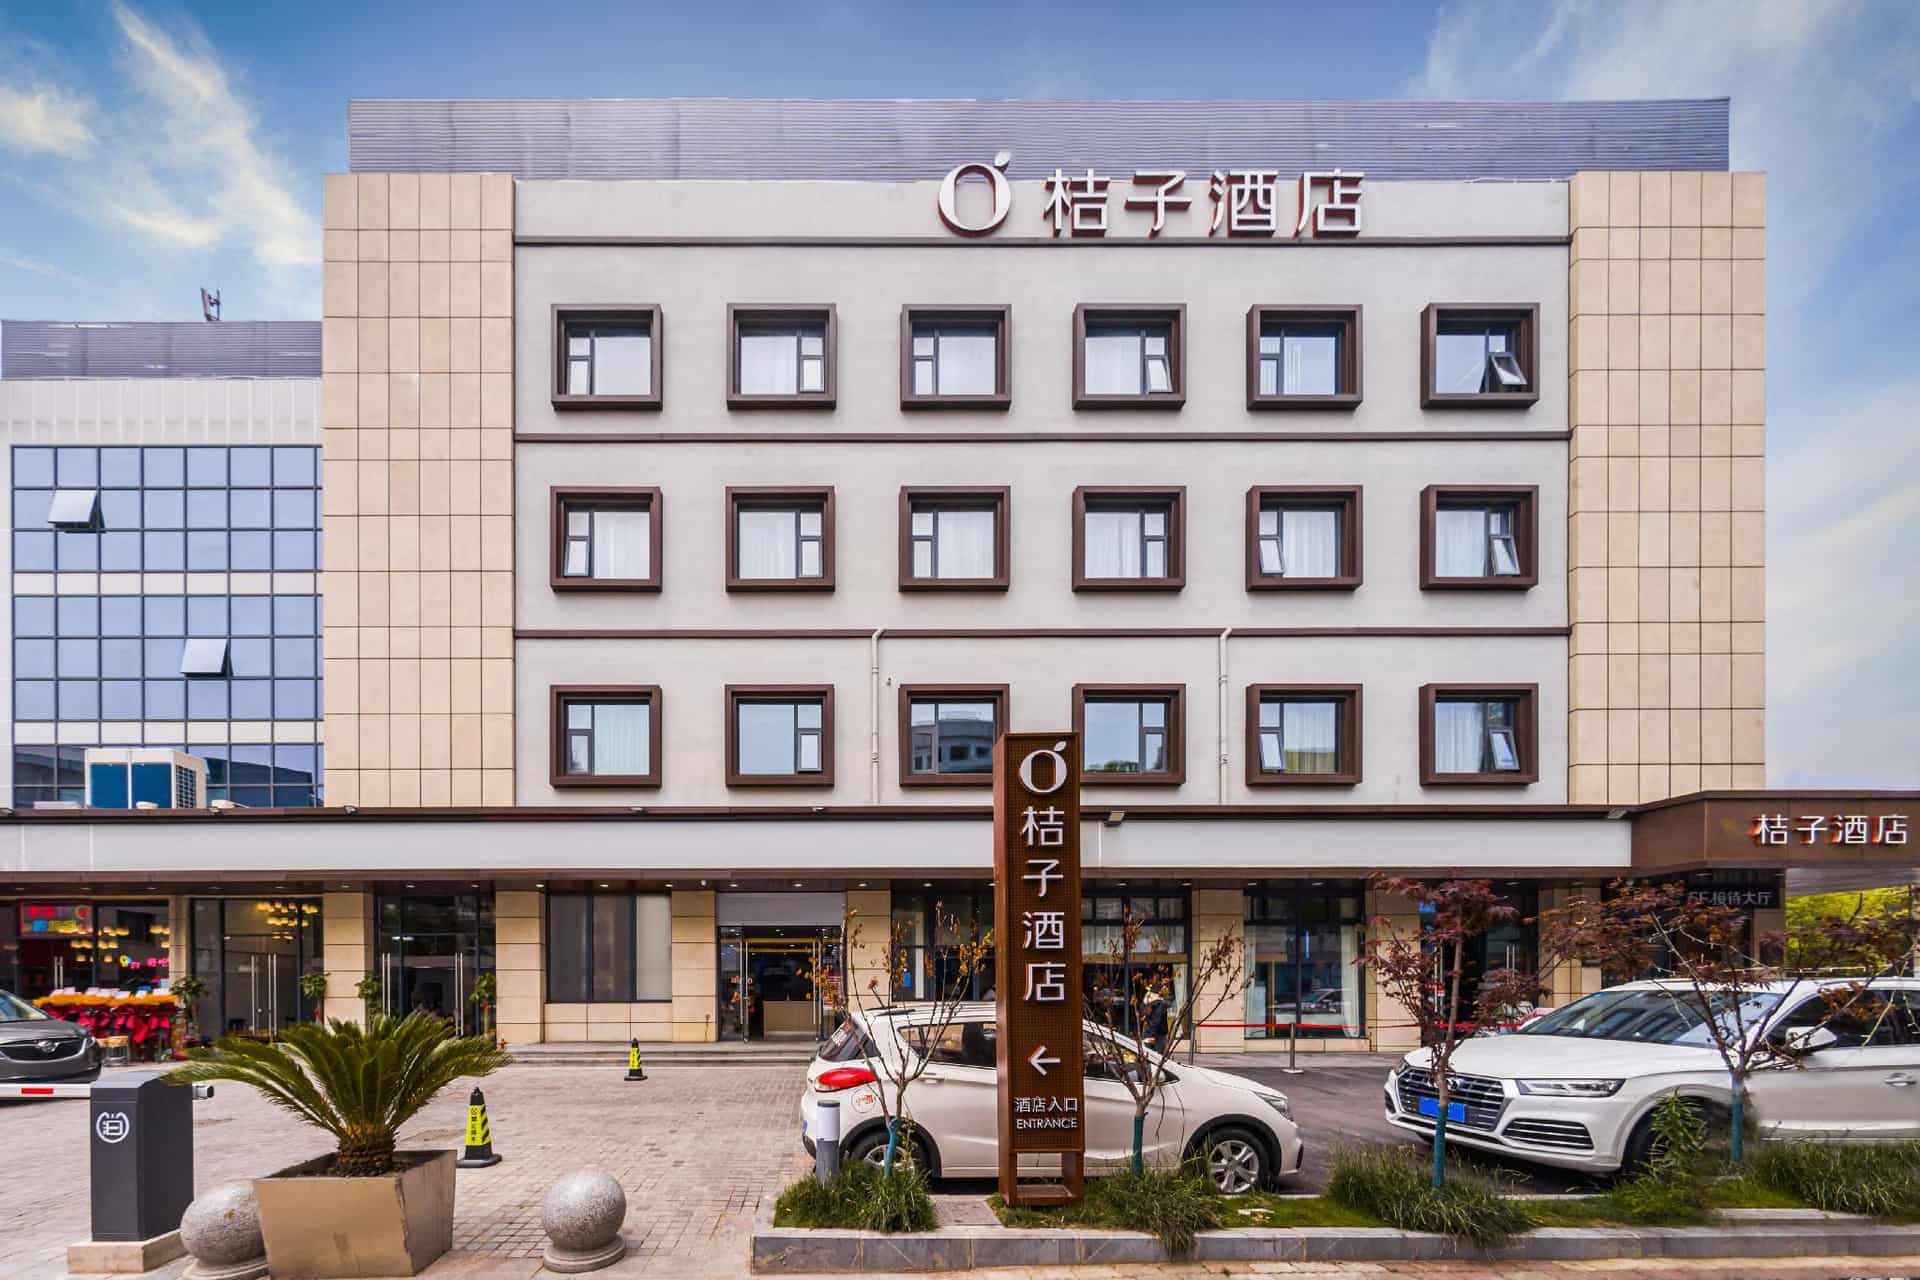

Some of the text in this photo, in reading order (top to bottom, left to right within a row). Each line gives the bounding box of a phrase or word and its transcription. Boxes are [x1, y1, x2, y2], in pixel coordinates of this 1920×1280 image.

[1043, 168, 1366, 238] 桔子酒店
[1752, 814, 1909, 844] 桔子酒店
[1021, 805, 1066, 1001] 桔子酒店
[1014, 1096, 1078, 1112] 酒店入口
[1016, 1118, 1078, 1129] ENTRANCE
